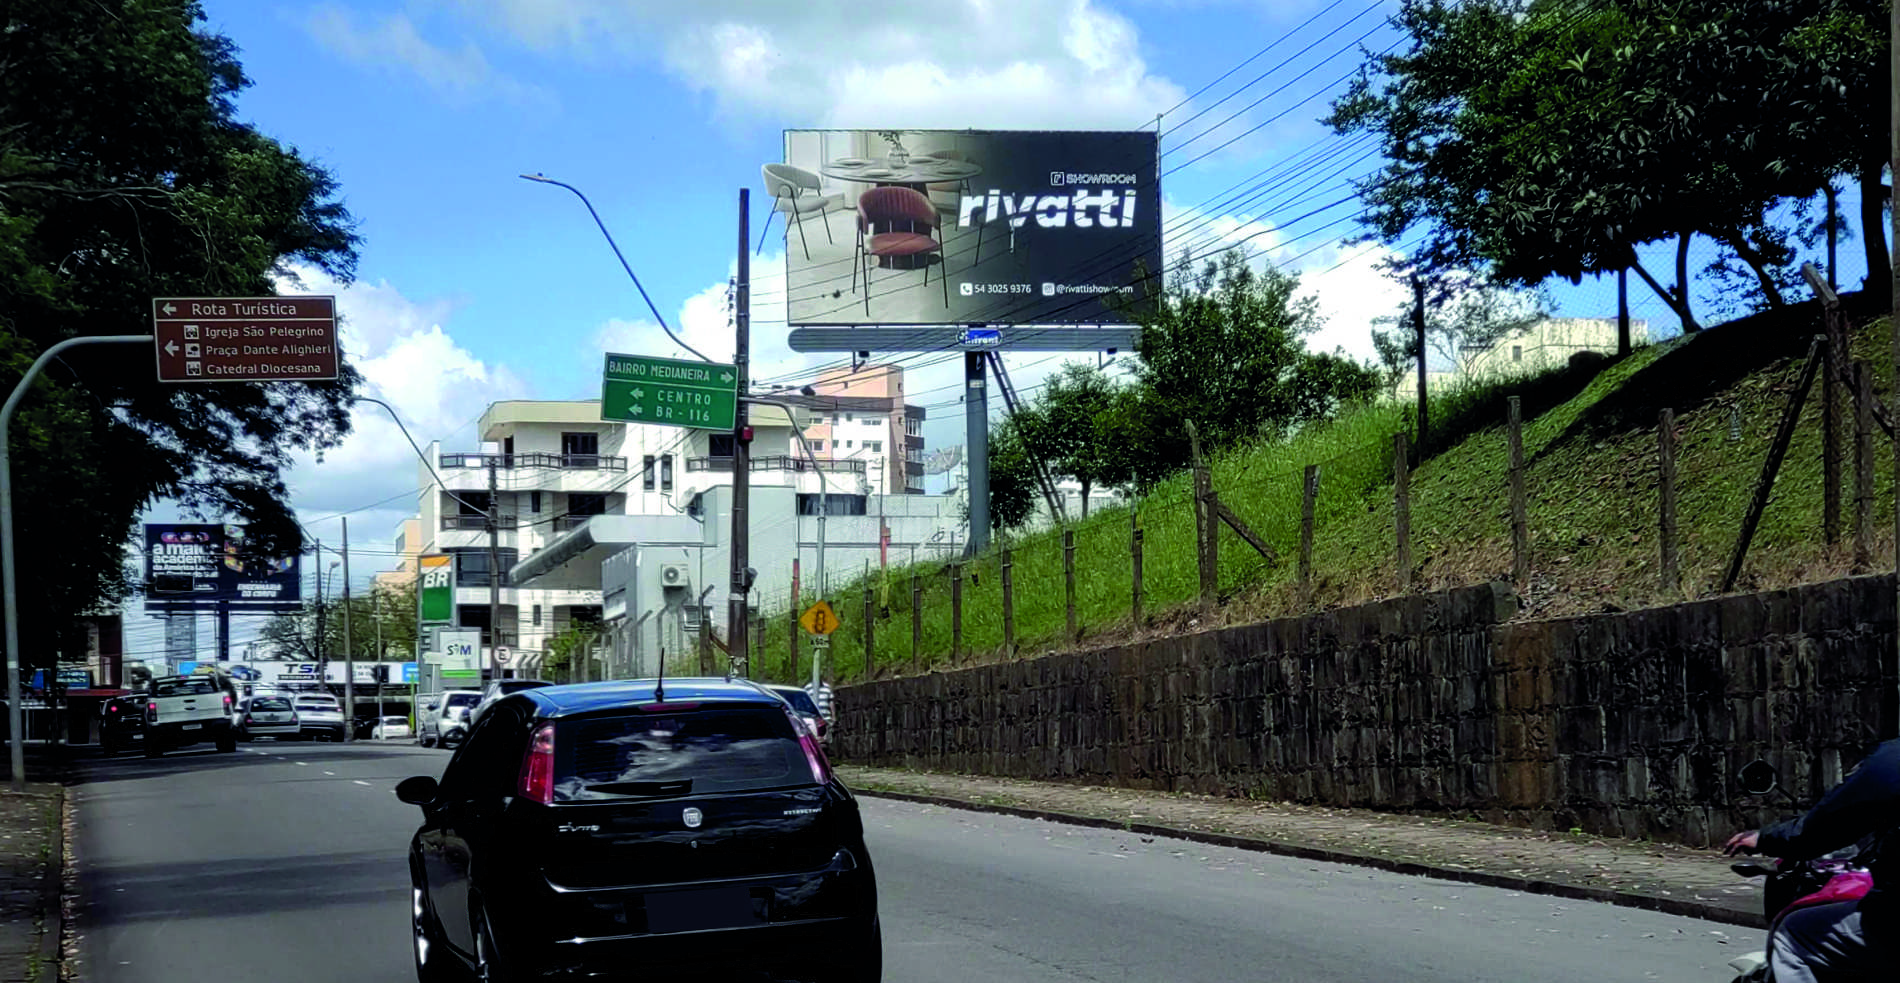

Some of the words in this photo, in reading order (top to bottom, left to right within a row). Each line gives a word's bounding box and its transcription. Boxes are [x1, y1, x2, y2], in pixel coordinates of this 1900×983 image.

[1066, 173, 1136, 184] SHOWROOM
[958, 189, 1137, 228] rivatti
[974, 283, 985, 294] 54
[987, 283, 1009, 294] 3025
[1010, 283, 1032, 294] 9376
[191, 302, 227, 316] Rota
[232, 301, 297, 316] Turística
[205, 326, 239, 340] Igreja
[243, 325, 265, 337] São
[269, 326, 324, 339] Pelegrino
[205, 345, 238, 358] Praça
[243, 344, 279, 355] Dante
[281, 343, 331, 357] Alighieri
[206, 363, 257, 375] Catedral
[260, 362, 321, 375] Diocesana
[609, 360, 646, 375] BAIRRO
[650, 365, 711, 382] MEDIANEIRA
[657, 390, 711, 406] CENTRO
[152, 543, 164, 555] a
[152, 555, 218, 564] academi
[423, 572, 449, 588] BR
